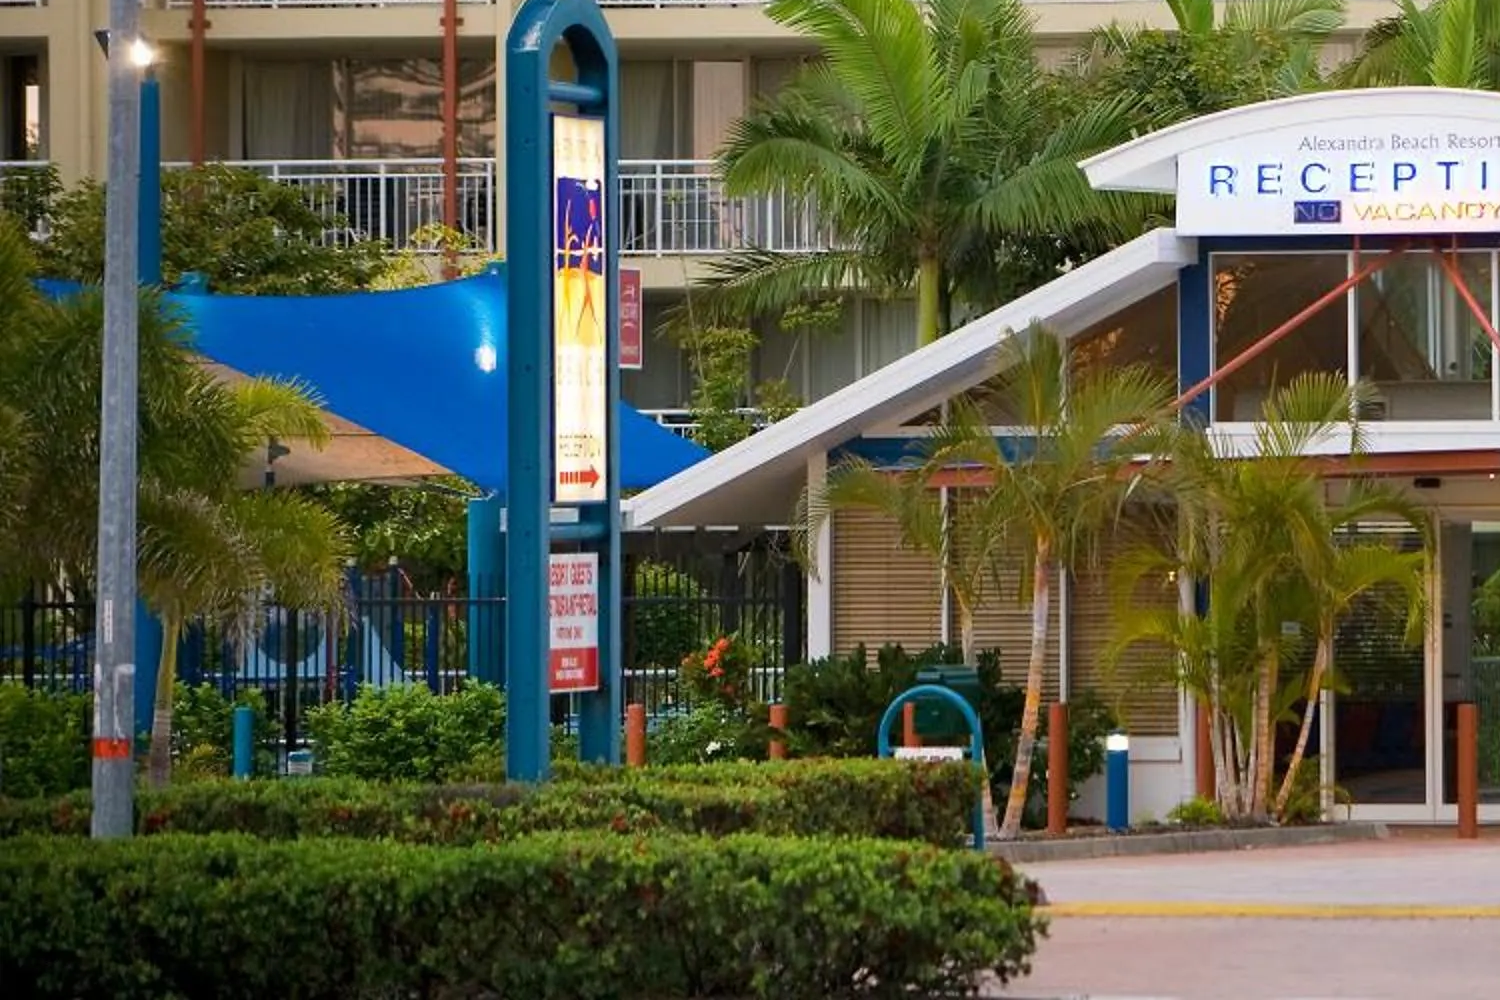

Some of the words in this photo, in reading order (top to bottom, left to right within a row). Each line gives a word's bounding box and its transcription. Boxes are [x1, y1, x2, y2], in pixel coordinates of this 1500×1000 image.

[1298, 135, 1385, 151] Alexandra
[1390, 133, 1440, 150] Beach
[1295, 202, 1338, 221] NO
